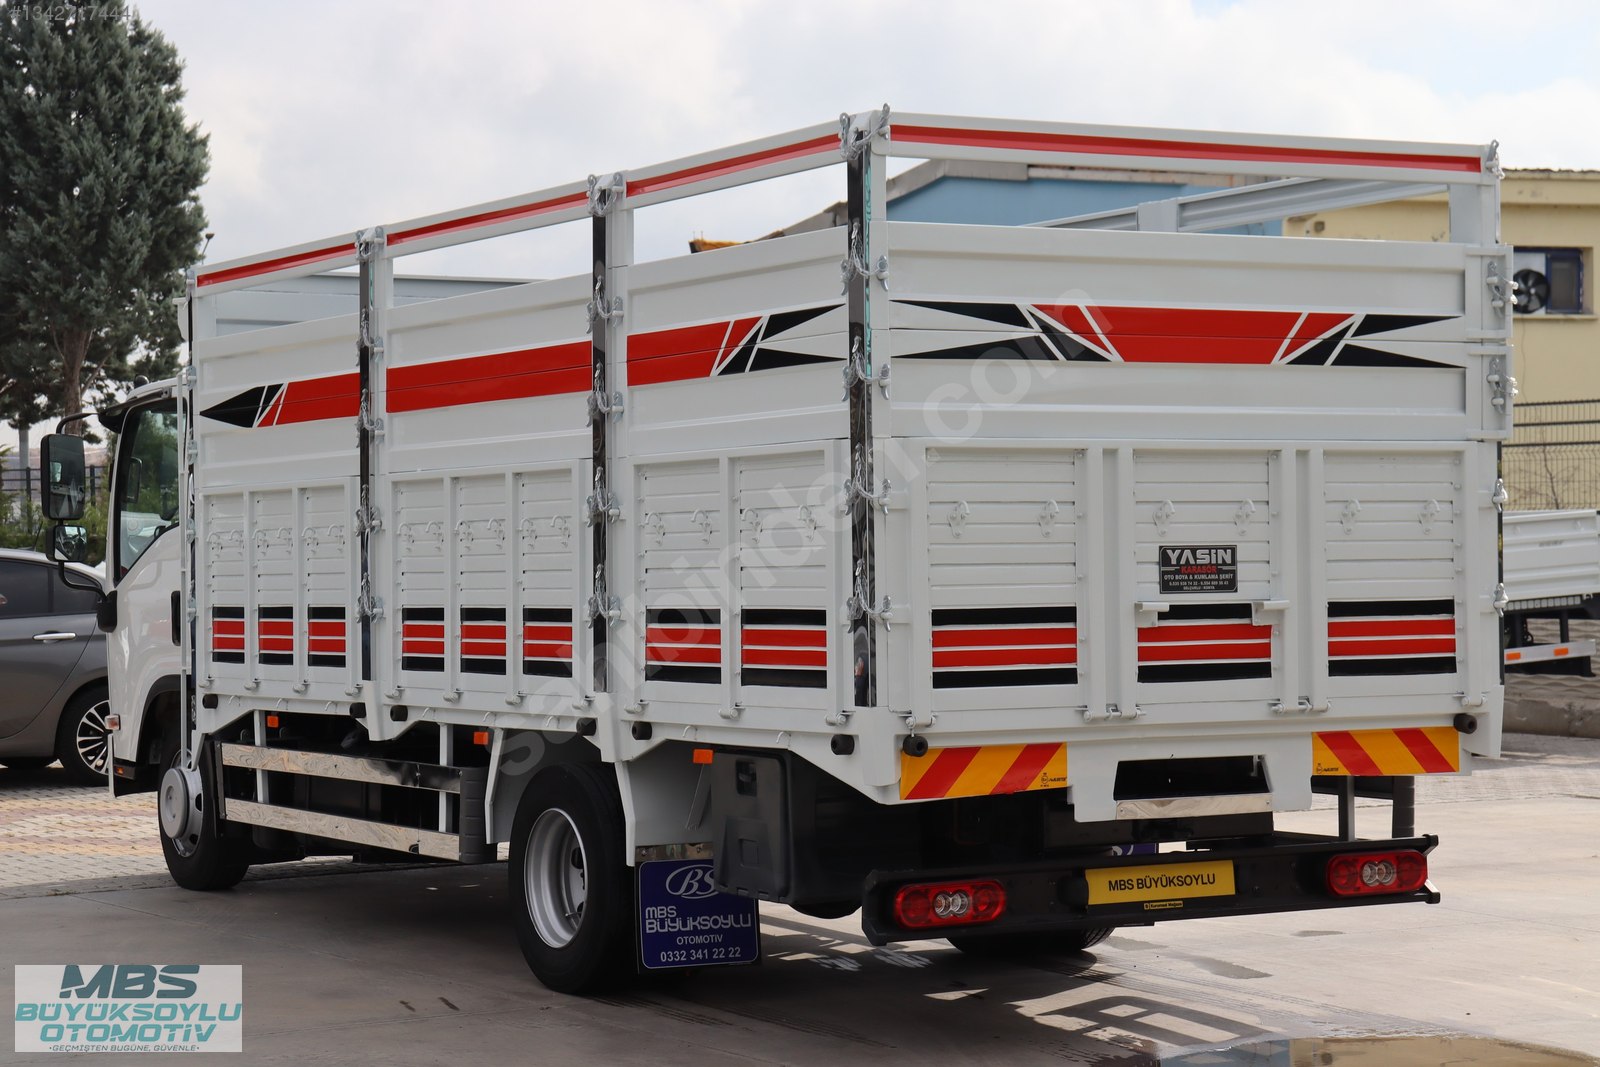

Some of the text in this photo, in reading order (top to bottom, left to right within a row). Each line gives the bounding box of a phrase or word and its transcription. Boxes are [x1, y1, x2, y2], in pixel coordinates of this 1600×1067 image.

[1108, 873, 1216, 892] MBS BÜYÜKSOYLU
[645, 905, 677, 919] MBS
[660, 946, 741, 962] 0332 341 22 22
